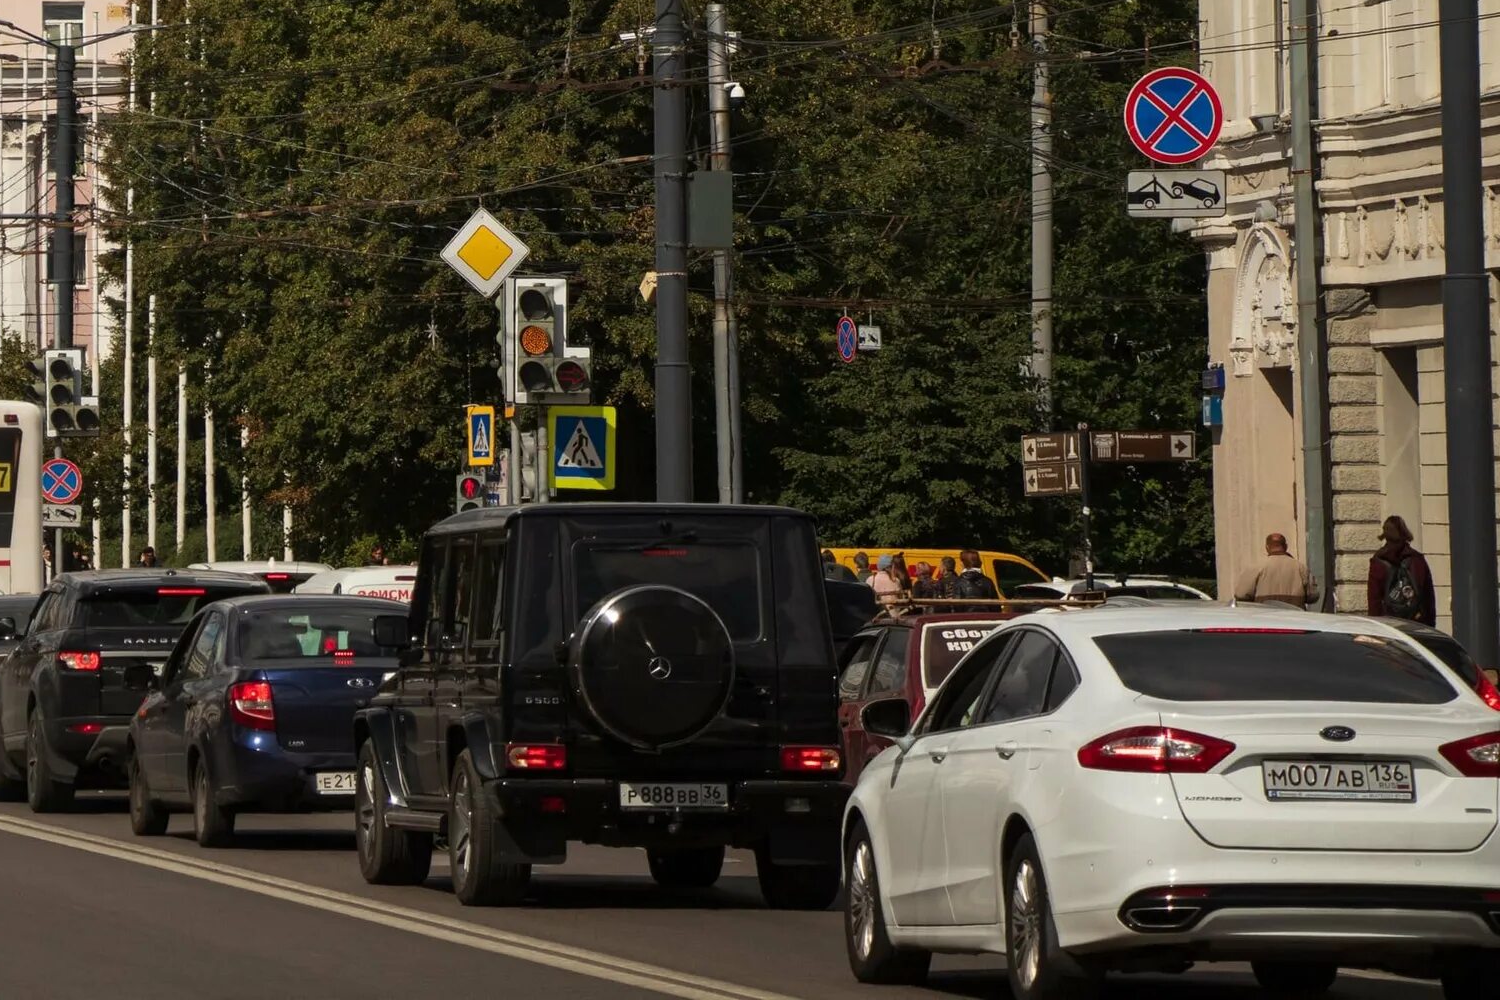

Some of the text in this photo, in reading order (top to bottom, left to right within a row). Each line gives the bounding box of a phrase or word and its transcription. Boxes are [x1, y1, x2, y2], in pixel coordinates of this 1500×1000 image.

[1369, 765, 1404, 782] 136
[323, 774, 357, 789] Е21
[703, 786, 721, 799] 36
